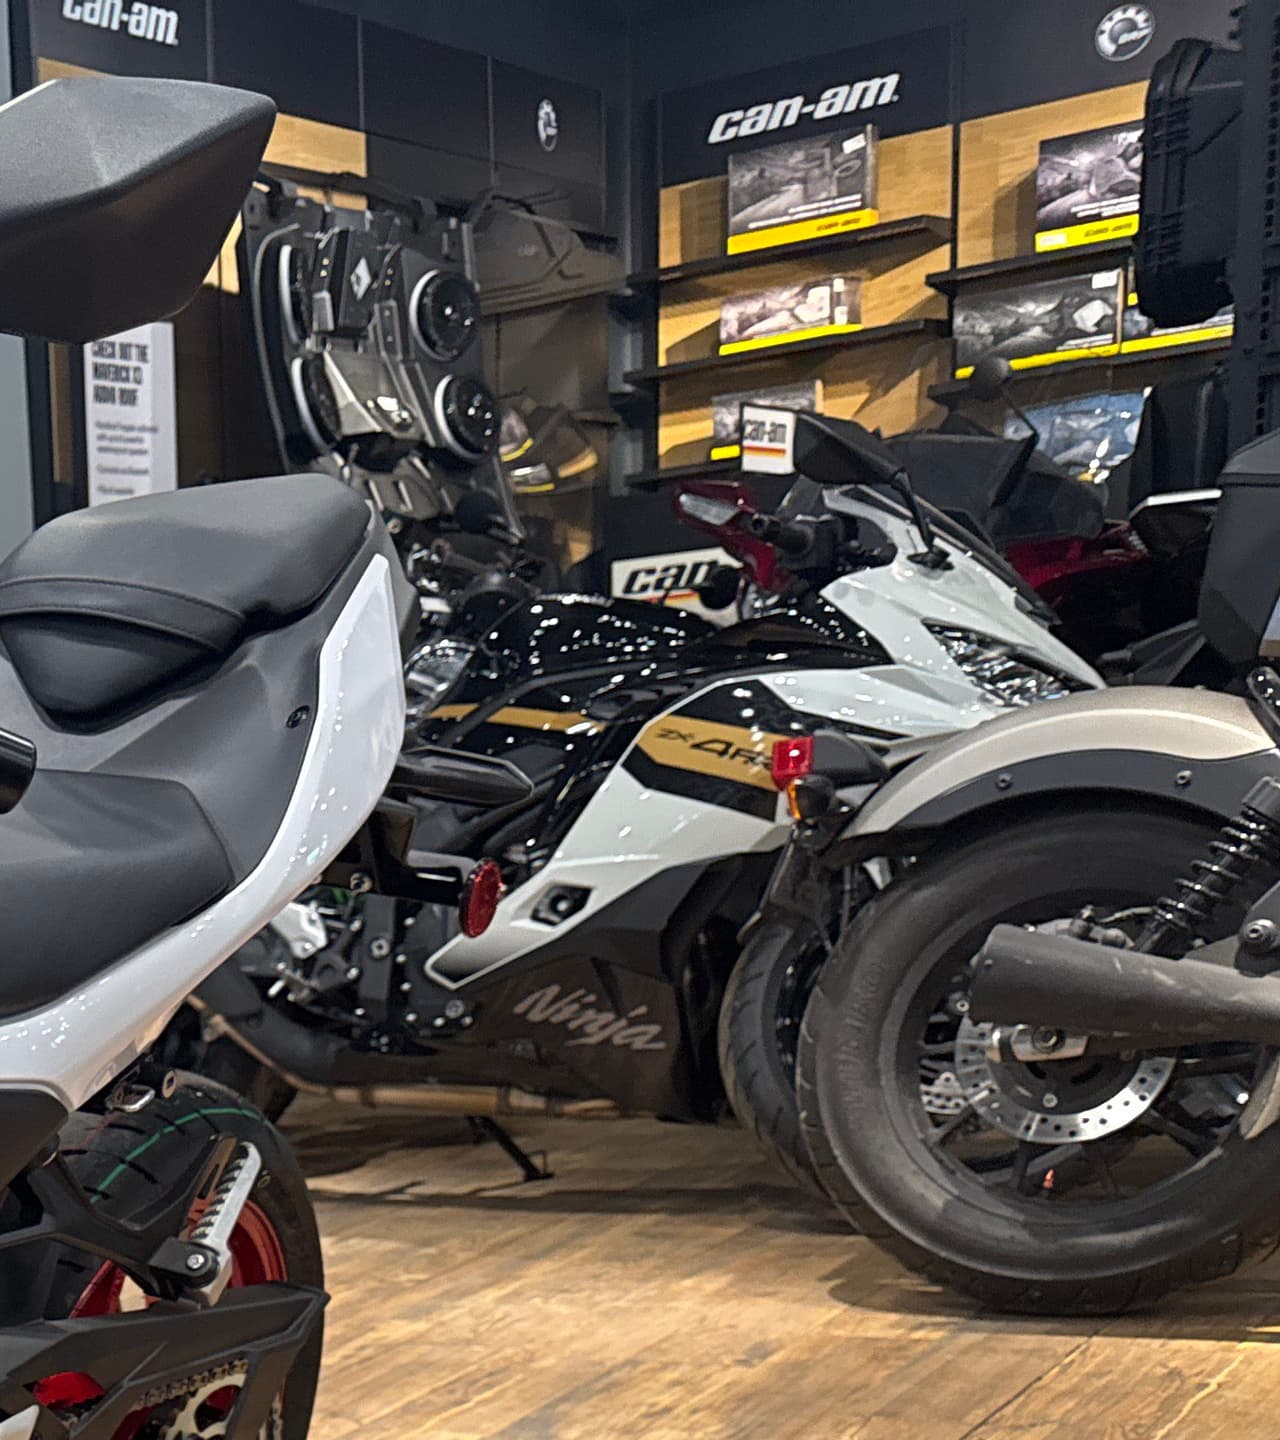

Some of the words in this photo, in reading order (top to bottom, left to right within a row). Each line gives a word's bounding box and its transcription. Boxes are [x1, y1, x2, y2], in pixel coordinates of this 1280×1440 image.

[62, 0, 178, 45] can-am
[708, 73, 899, 144] can-am
[513, 984, 667, 1050] Ninja
